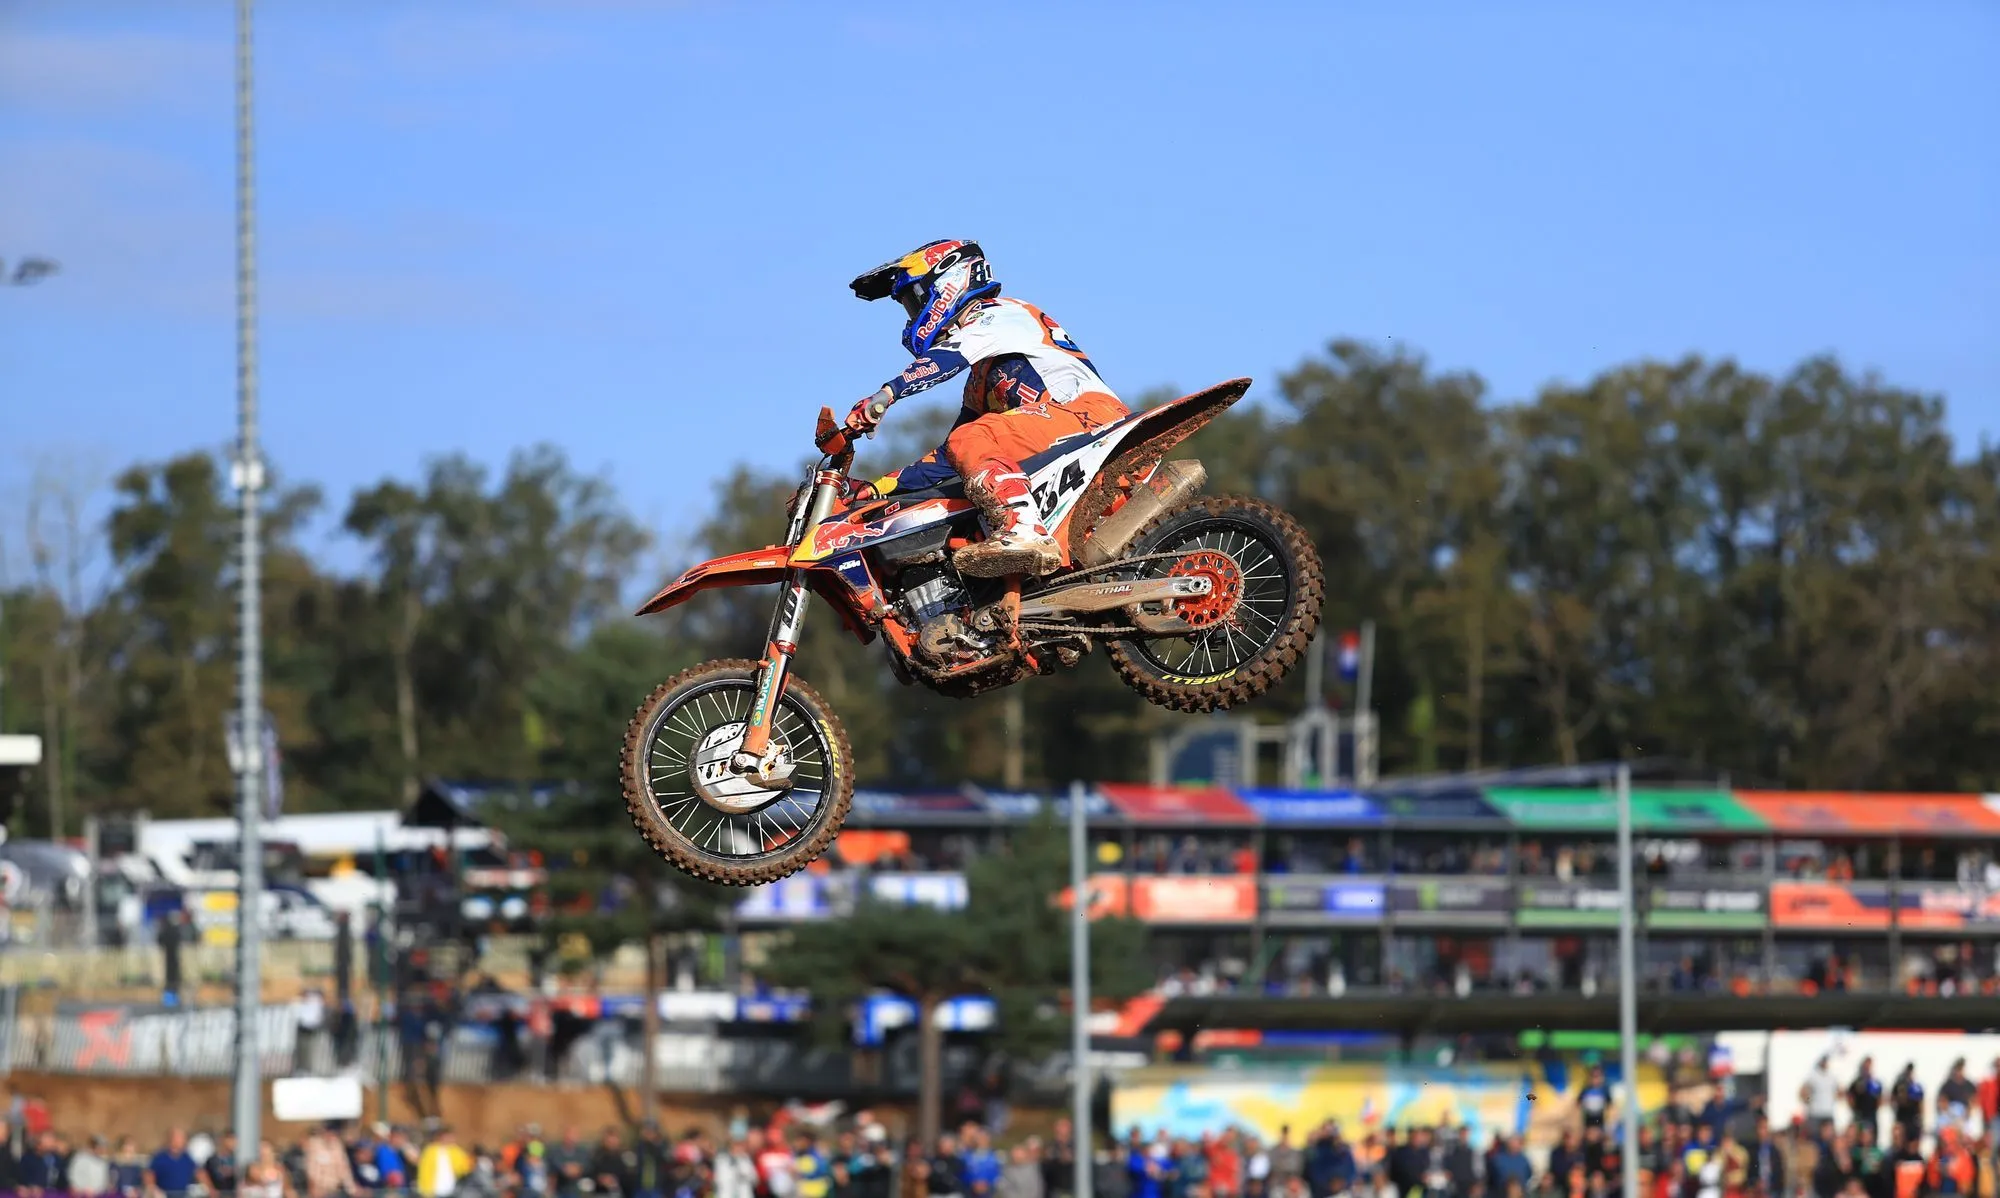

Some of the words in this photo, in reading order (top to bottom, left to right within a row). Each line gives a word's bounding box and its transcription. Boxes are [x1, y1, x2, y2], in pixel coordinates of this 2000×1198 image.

[917, 309, 942, 340] Red
[933, 282, 958, 313] Bull
[902, 367, 923, 383] Red
[920, 362, 940, 377] Bull
[839, 560, 860, 571] KTM
[1161, 668, 1237, 685] PIRELLI
[818, 719, 840, 779] PIRELLI
